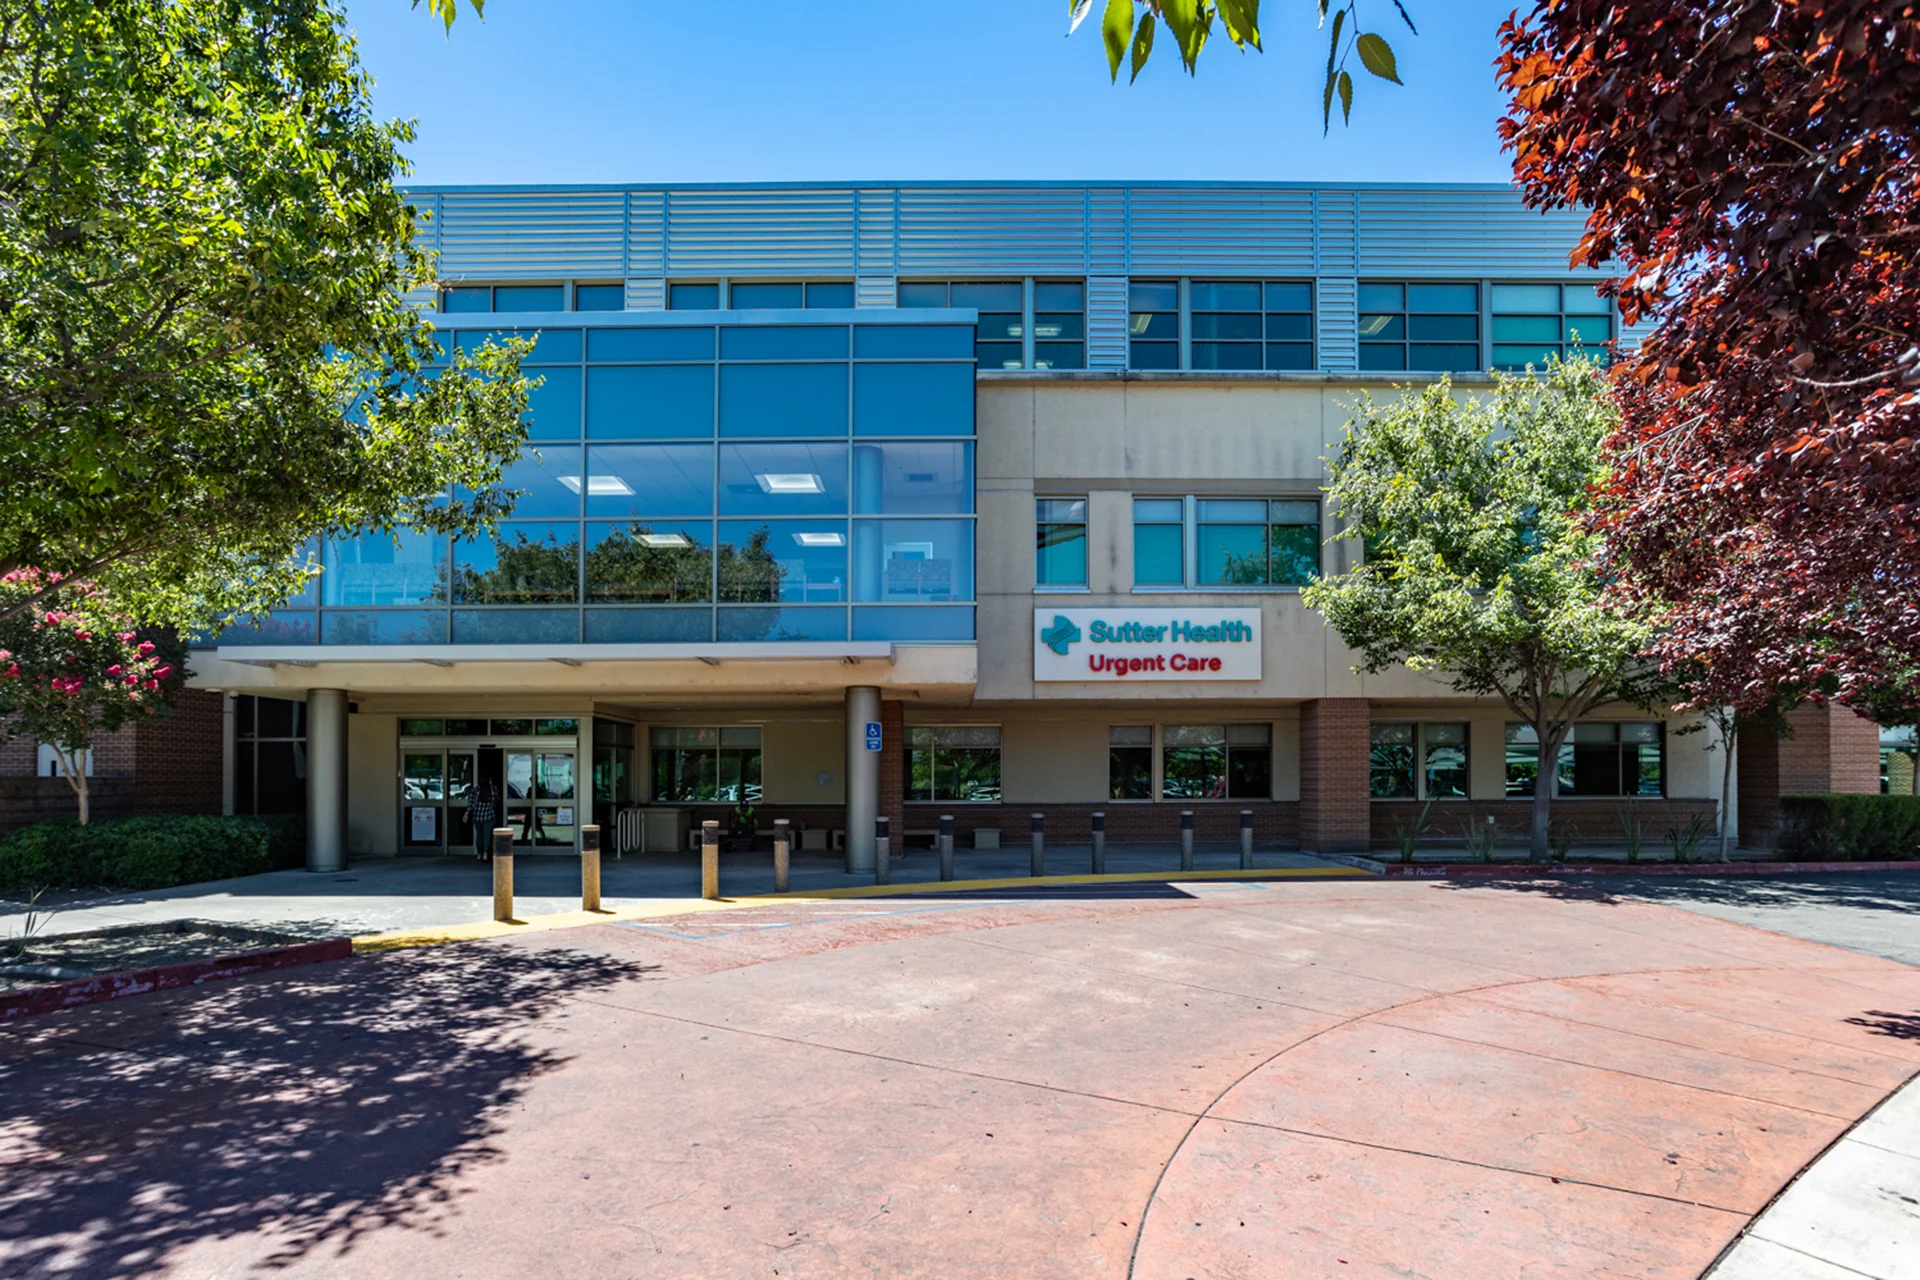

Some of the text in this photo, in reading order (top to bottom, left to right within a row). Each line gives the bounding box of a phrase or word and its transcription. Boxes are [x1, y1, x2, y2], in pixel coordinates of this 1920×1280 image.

[1089, 619, 1253, 643] Sutter Health
[1088, 653, 1222, 677] Urgent Care
